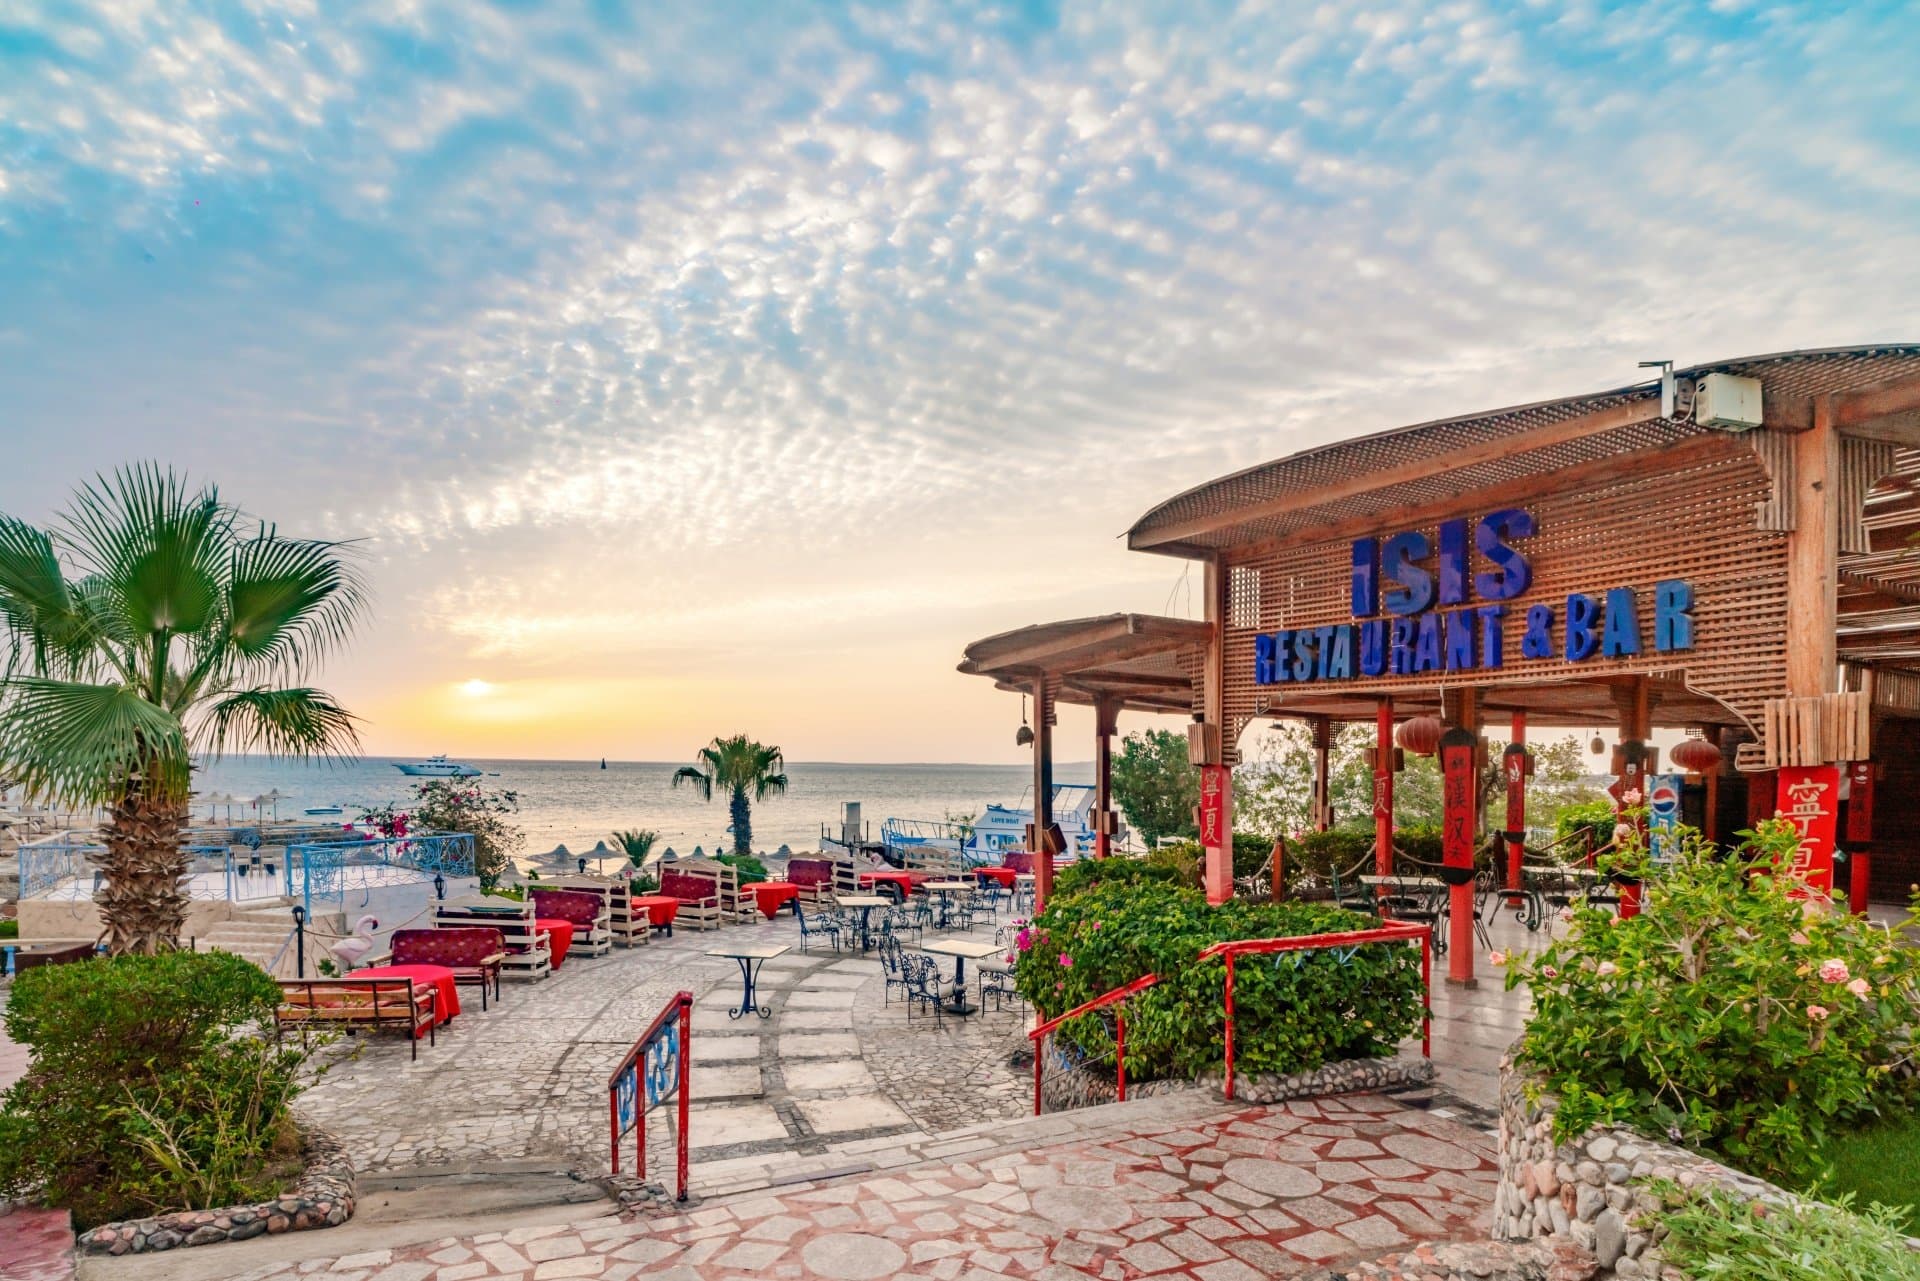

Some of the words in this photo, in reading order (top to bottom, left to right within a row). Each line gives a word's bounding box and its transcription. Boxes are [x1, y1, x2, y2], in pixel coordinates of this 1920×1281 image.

[1351, 507, 1538, 618] ISIS
[1255, 605, 1507, 685] RESTAURANT
[1521, 604, 1555, 659] &
[1566, 580, 1695, 662] BAR
